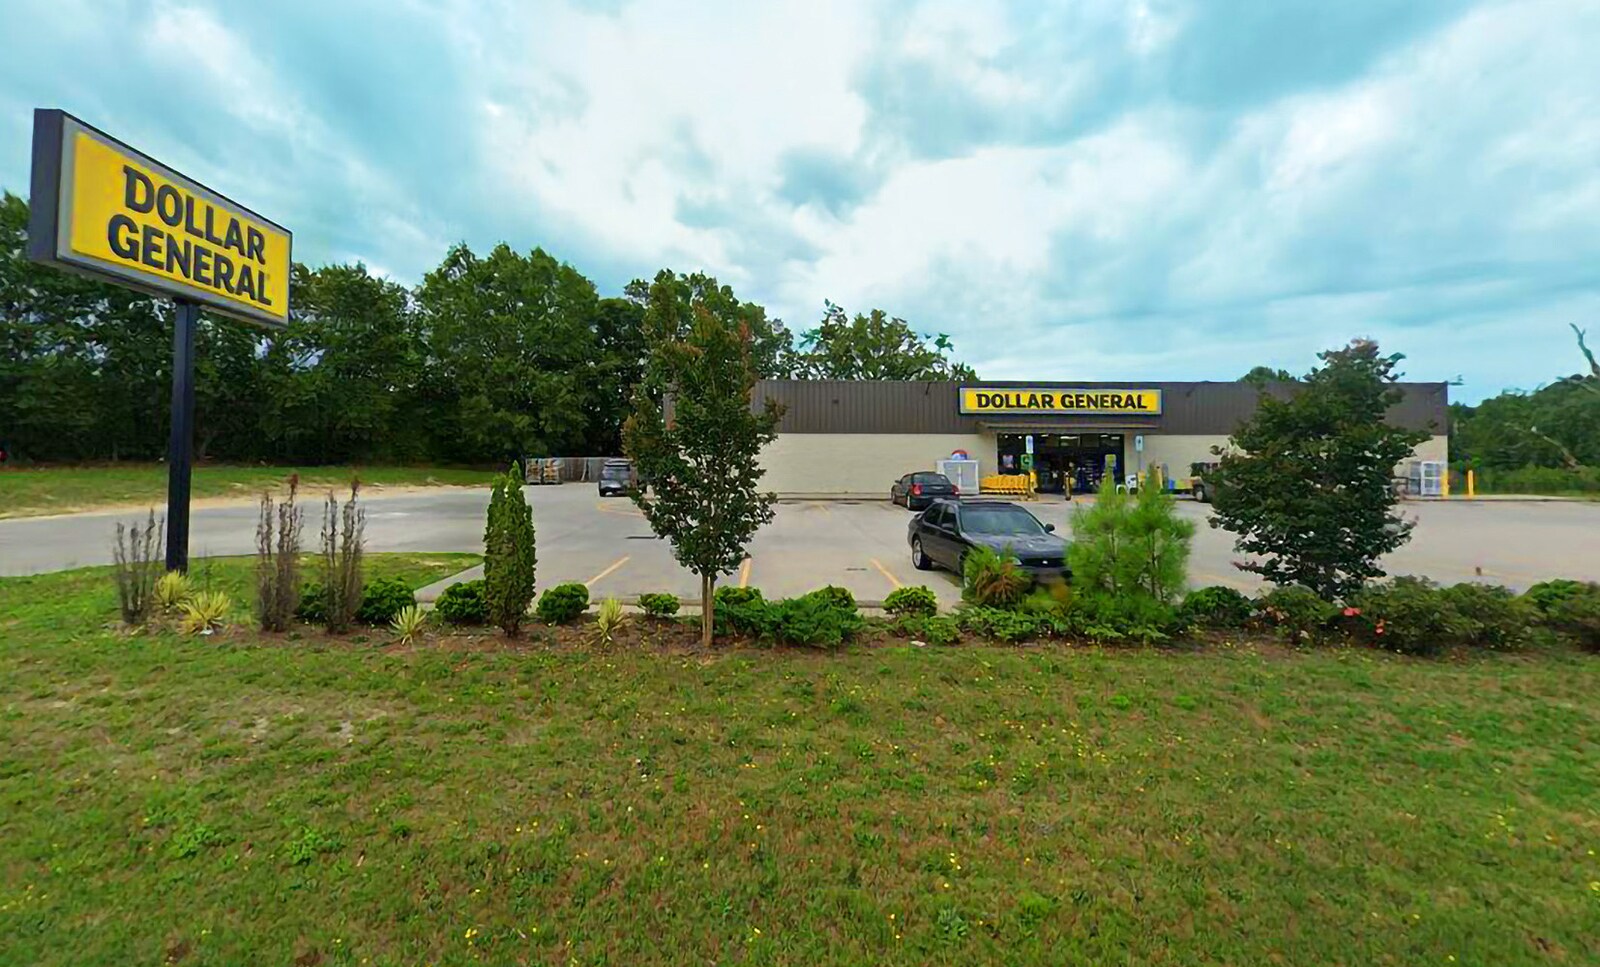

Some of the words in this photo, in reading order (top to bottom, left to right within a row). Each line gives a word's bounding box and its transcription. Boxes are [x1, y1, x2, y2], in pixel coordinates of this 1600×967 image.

[107, 213, 272, 306] GENERAL
[123, 164, 266, 265] DOLLAR
[976, 393, 1054, 409] DOLLAR
[1060, 393, 1148, 410] GENERAL
